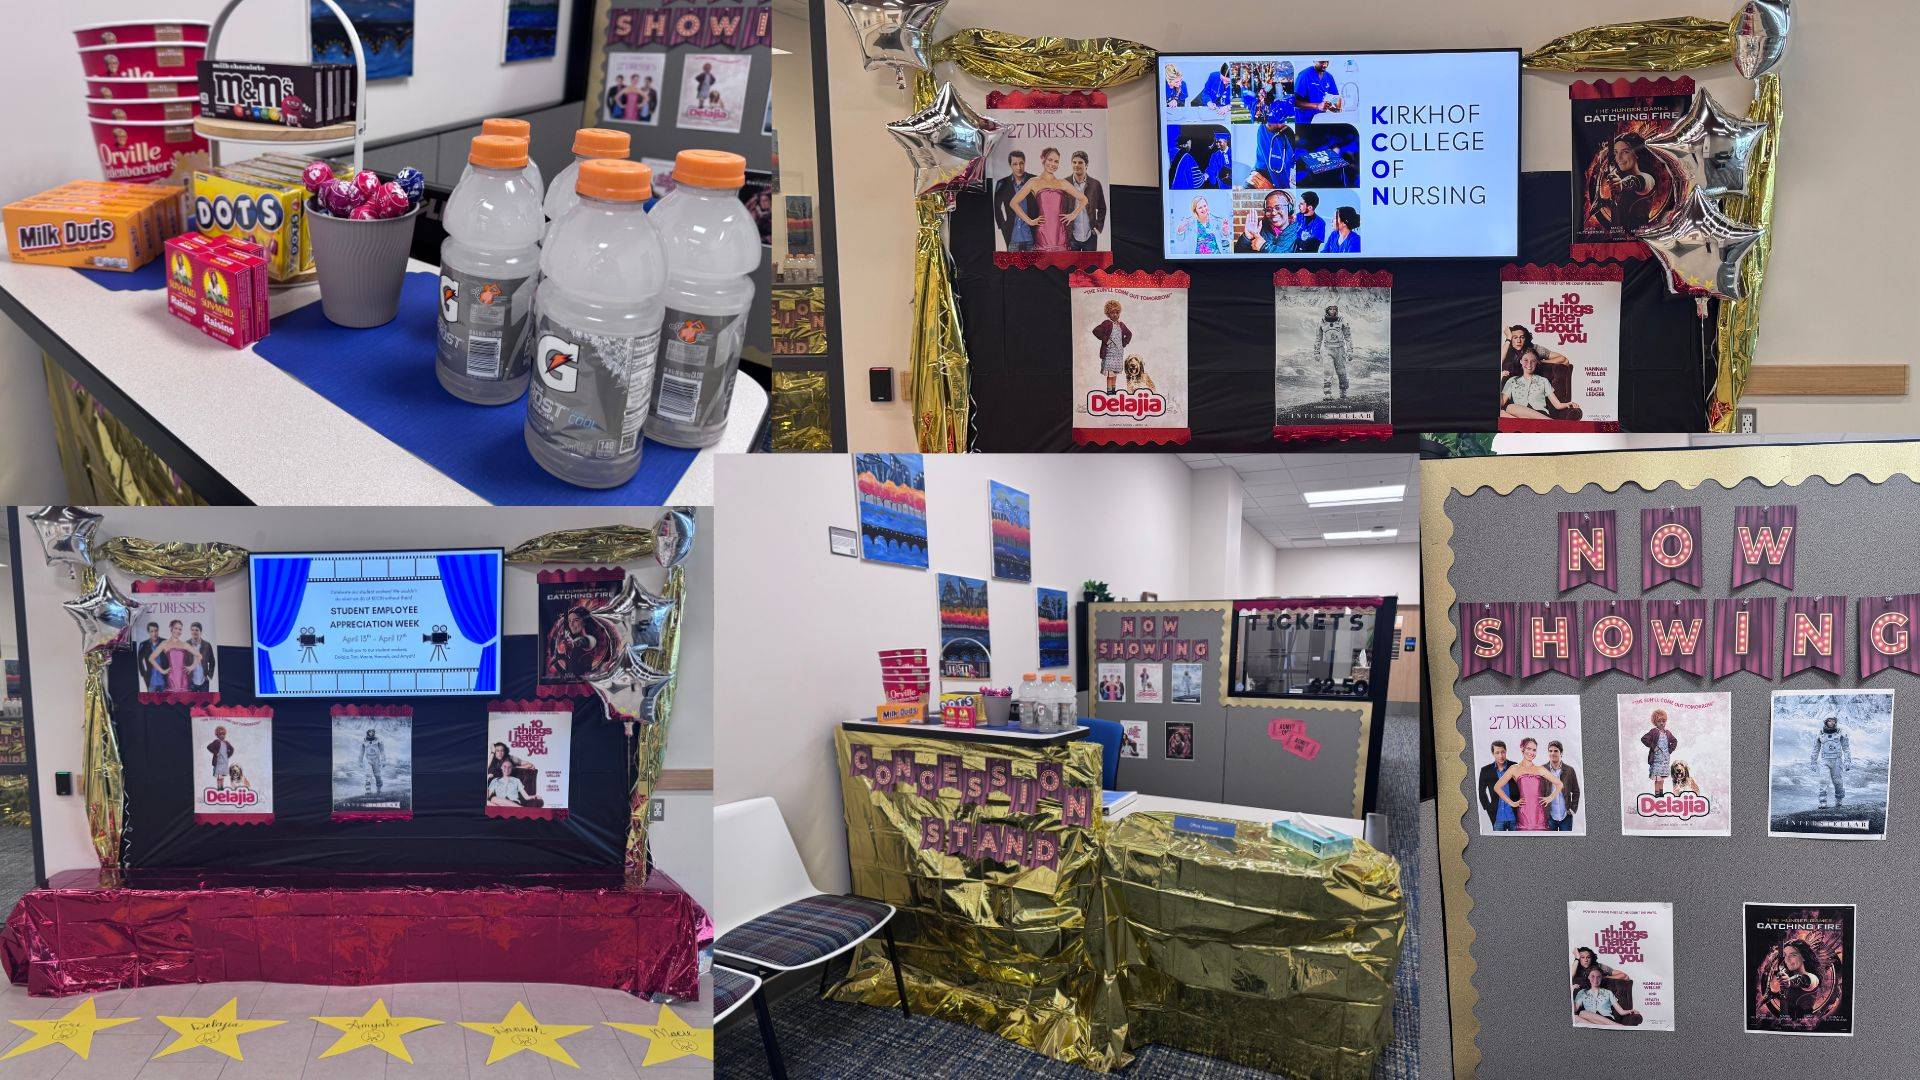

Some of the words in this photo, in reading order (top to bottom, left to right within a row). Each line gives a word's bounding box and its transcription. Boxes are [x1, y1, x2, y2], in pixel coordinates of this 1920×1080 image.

[1371, 104, 1480, 125] KIRKHOF
[1584, 112, 1648, 123] CATCHING
[1651, 111, 1680, 121] FIRE
[1008, 123, 1025, 138] 27
[1027, 123, 1094, 139] DRESSES
[1371, 131, 1485, 152] COLLEGE
[100, 142, 161, 166] Orville
[1371, 159, 1404, 179] OF
[1372, 185, 1486, 206] NURSING
[196, 197, 279, 229] DOTS
[19, 224, 60, 249] Milk
[64, 218, 114, 244] Duds
[1561, 292, 1580, 305] 10
[1538, 298, 1594, 318] things
[1530, 307, 1536, 325] I
[1540, 308, 1577, 324] hate
[203, 314, 235, 335] Raisins
[1534, 318, 1584, 333] about
[1558, 332, 1588, 346] you
[537, 334, 580, 392] G
[1091, 393, 1162, 416] Delajia
[1567, 524, 1793, 571] NOW
[594, 591, 613, 599] FIRE
[160, 601, 206, 614] DRESSES
[330, 606, 370, 615] STUDENT
[372, 605, 418, 614] EMPLOYEE
[330, 620, 393, 629] APPRECIATION
[395, 619, 420, 628] WEEK
[1123, 620, 1178, 632] NOW
[1249, 612, 1364, 632] TICKETS
[379, 635, 395, 644] April
[1474, 611, 1909, 659] SHOWING
[1099, 642, 1207, 656] SHOWING
[882, 710, 897, 720] Milk
[1489, 716, 1505, 730] 27
[1507, 715, 1567, 730] DRESSES
[513, 724, 553, 736] things
[515, 730, 541, 742] hate
[511, 737, 545, 749] about
[527, 747, 548, 757] you
[854, 751, 1087, 819] CONCESSION
[206, 790, 255, 805] Delajia
[1640, 796, 1706, 816] Delajia
[926, 822, 1055, 862] STAND
[1600, 924, 1649, 942] things
[1620, 920, 1636, 931] 10
[1756, 922, 1814, 930] CATCHING
[1594, 933, 1599, 948] I
[1602, 933, 1633, 947] hate
[1598, 942, 1641, 954] about
[1619, 953, 1644, 965] you
